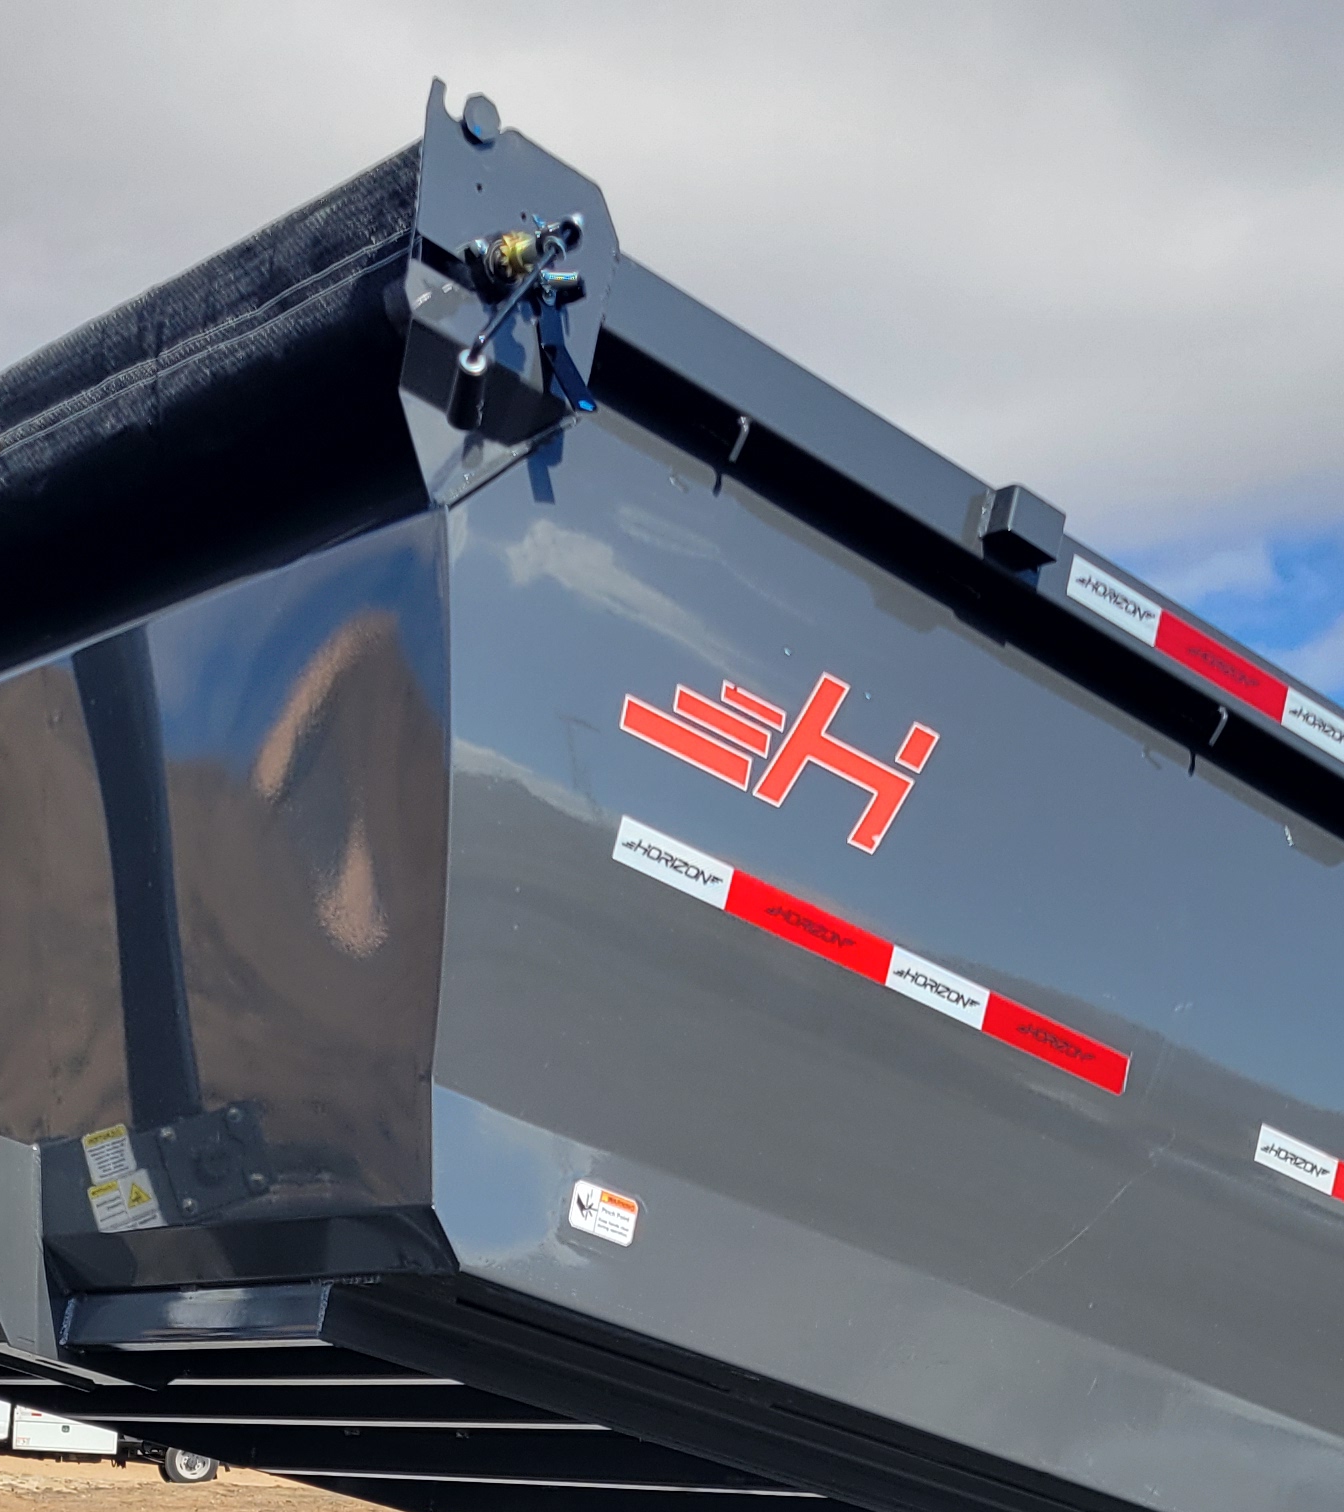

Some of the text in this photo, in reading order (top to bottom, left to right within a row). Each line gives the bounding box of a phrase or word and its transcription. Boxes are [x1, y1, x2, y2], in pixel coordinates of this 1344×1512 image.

[1083, 574, 1148, 621] HORIZON
[630, 837, 715, 887] HORIZON
[902, 965, 971, 1010] HORIZON
[1268, 1142, 1322, 1178] HORIZON
